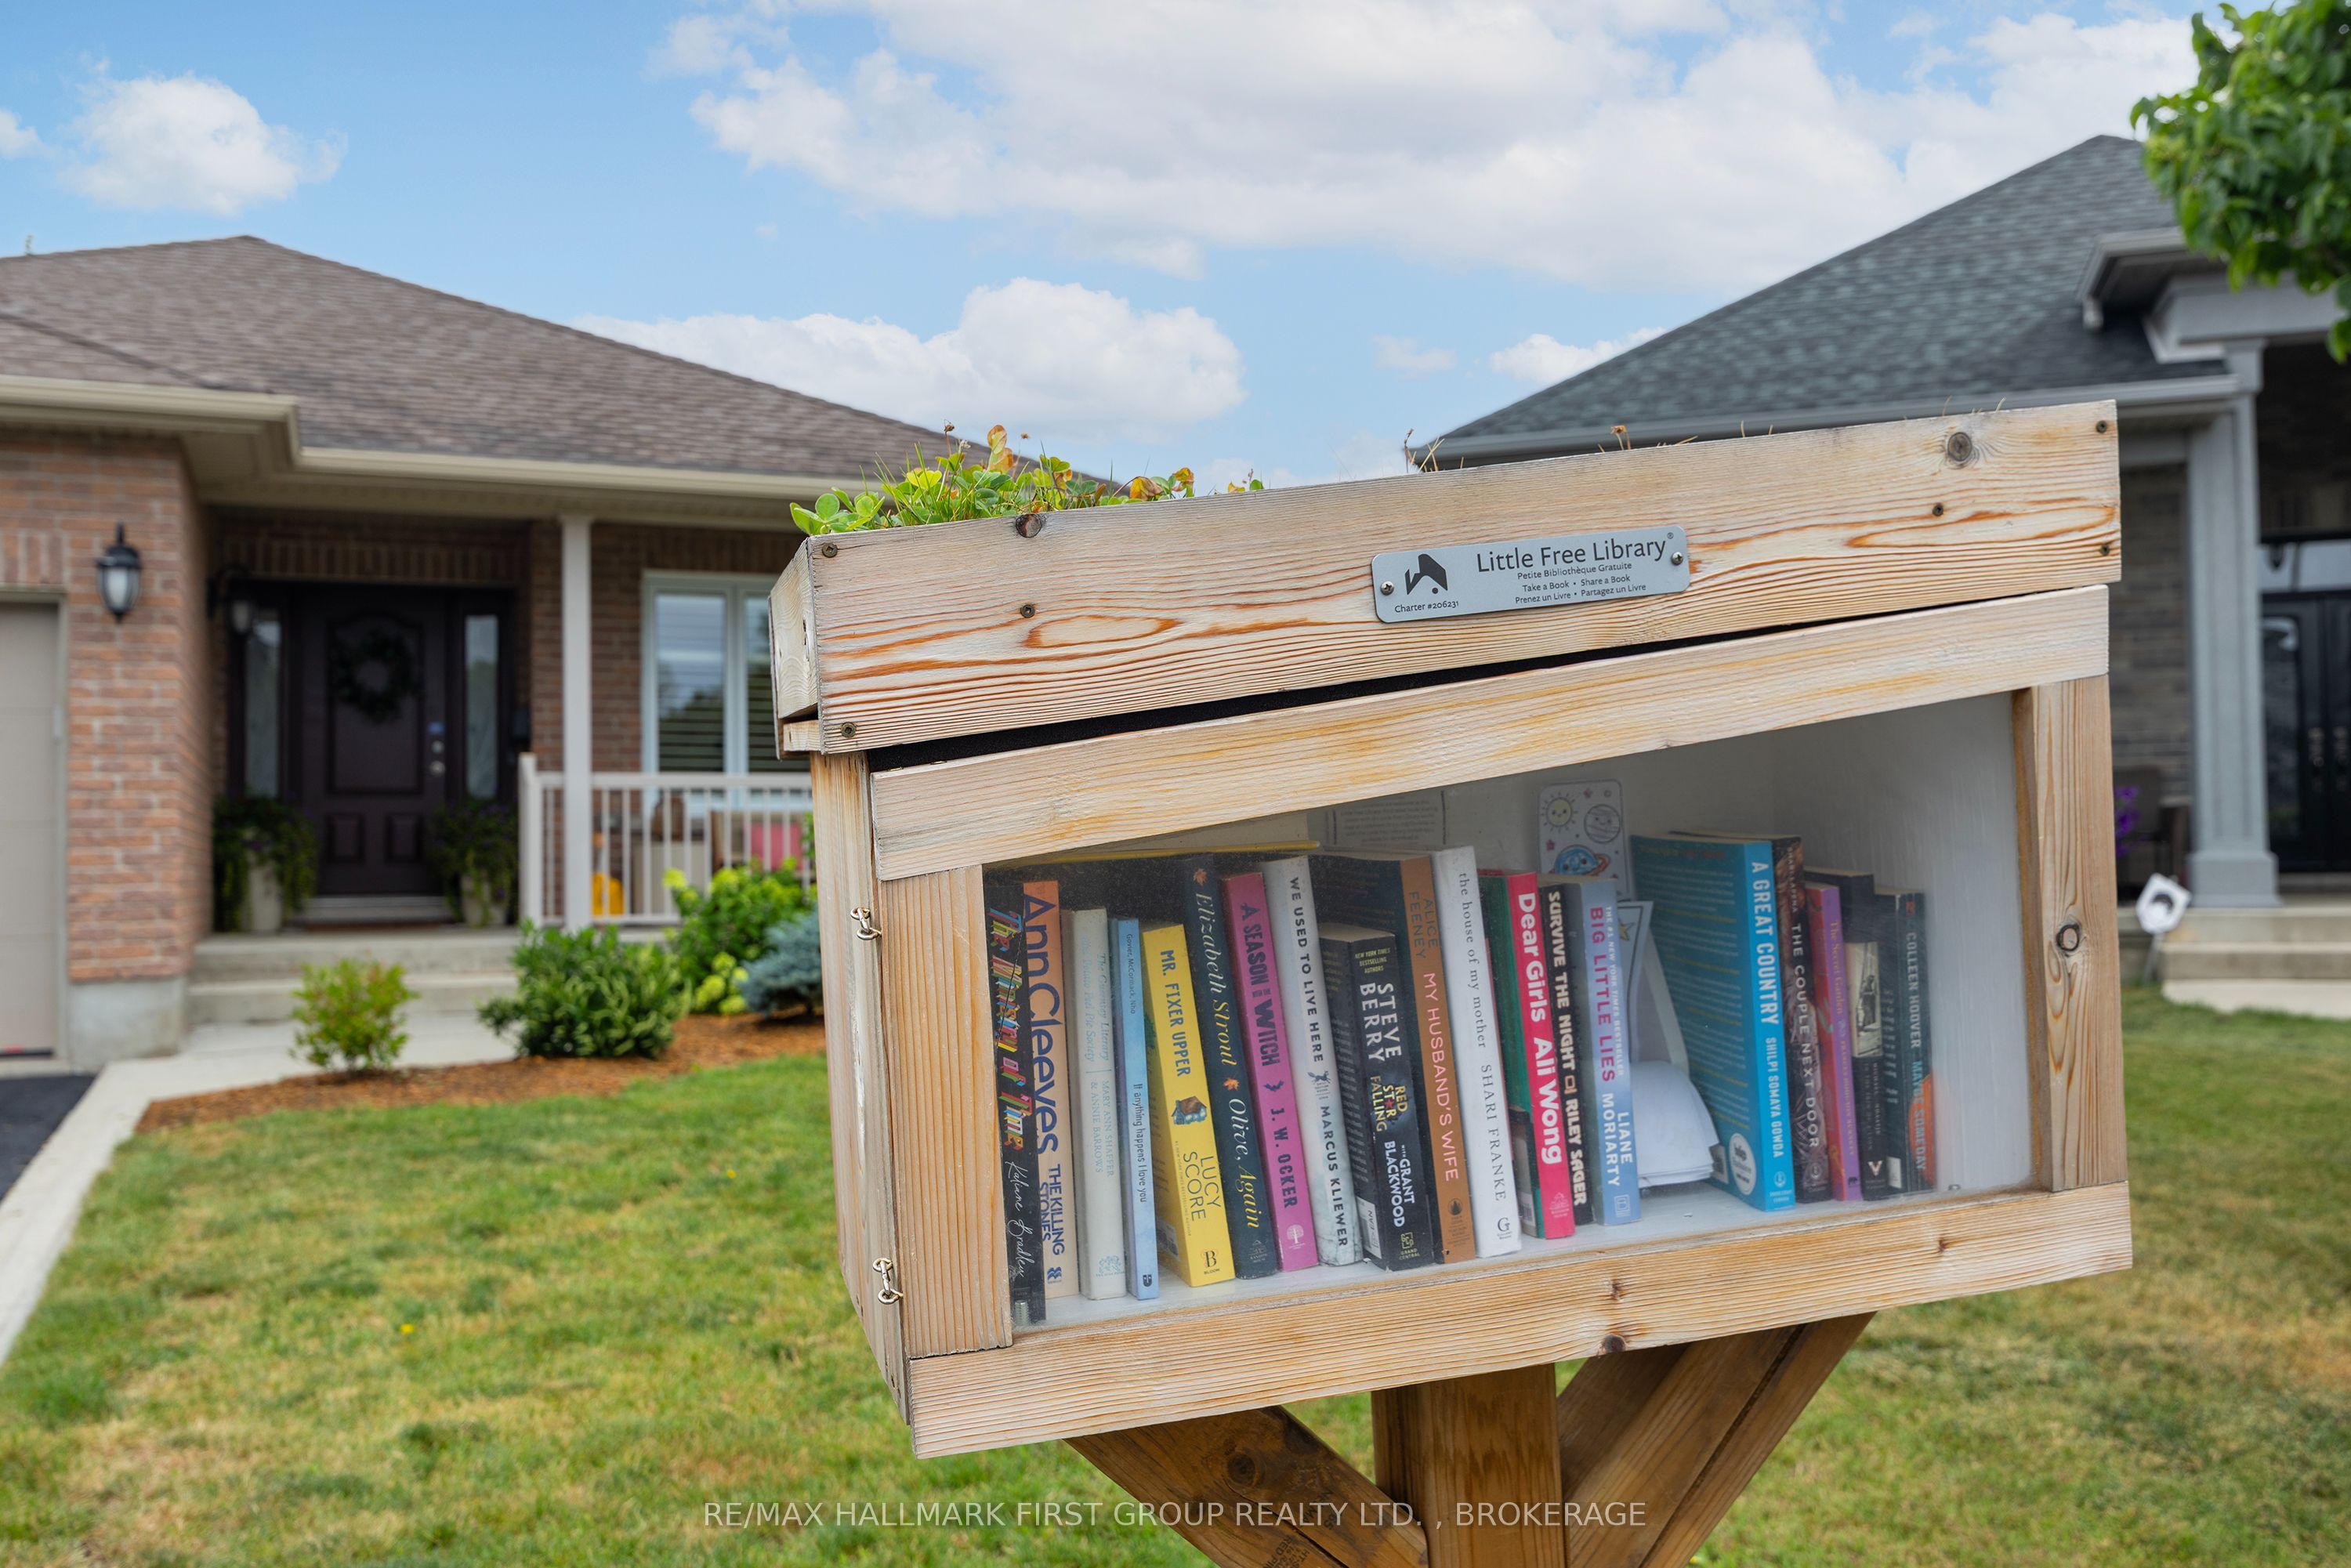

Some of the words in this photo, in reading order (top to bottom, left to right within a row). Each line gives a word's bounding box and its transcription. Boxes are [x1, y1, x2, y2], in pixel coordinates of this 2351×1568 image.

[1476, 547, 1534, 573] Little
[1540, 545, 1586, 567] Free
[1517, 570, 1541, 580] Petite
[1544, 566, 1596, 578] Bibliothèque
[1598, 562, 1632, 572] Gratuite
[1581, 578, 1604, 587] Share
[1612, 574, 1631, 583] Book
[1394, 603, 1425, 614] Charter
[1427, 600, 1459, 610] #206231
[1516, 595, 1541, 604] Prenez
[1554, 591, 1571, 600] Livre
[1522, 583, 1541, 592] Take
[1549, 580, 1570, 589] Book
[1581, 588, 1614, 598] Partagez
[1628, 583, 1646, 592] Livre
[1290, 877, 1301, 901] WE
[1459, 872, 1468, 896] the
[1752, 861, 1769, 873] A
[1241, 903, 1260, 921] A
[1294, 907, 1307, 947] USED
[1409, 891, 1425, 959] FEENEY
[1423, 899, 1437, 947] ALICE
[1462, 901, 1473, 943] house
[1519, 893, 1539, 957] Dear
[1549, 890, 1566, 969] SURVIVE
[1590, 907, 1605, 944] BIG
[1752, 880, 1773, 936] GREAT
[1830, 919, 1838, 938] The
[1023, 893, 1057, 976] Ann
[1244, 924, 1269, 985] SEASON
[1791, 924, 1802, 958] THE
[1831, 942, 1840, 971] Secret
[1097, 953, 1106, 972] The
[1127, 958, 1136, 998] McCormack,
[1160, 950, 1176, 976] MR.
[1196, 893, 1226, 993] Elizabeth
[1213, 999, 1237, 1066] Strout
[1300, 954, 1311, 974] TO
[1360, 956, 1387, 966] BESTSELLING
[1468, 950, 1480, 965] of
[1468, 969, 1480, 990] my
[1906, 931, 1918, 988] COLLEEN
[991, 954, 1023, 1052] Ministry
[1099, 975, 1110, 1019] Guernsey
[1165, 983, 1184, 1027] FIXER
[1303, 980, 1317, 1016] LIVE
[1424, 973, 1439, 1001] MY
[1526, 961, 1548, 1023] Girls
[1555, 972, 1570, 1009] THE
[1594, 954, 1611, 1026] LITTLE
[1607, 926, 1614, 938] #1
[1614, 1020, 1625, 1076] BESTSELLER
[1757, 943, 1779, 1026] COUNTRY
[1794, 965, 1809, 1034] COUPLE
[1833, 975, 1843, 1012] Garden
[1085, 1012, 1095, 1027] Pie
[1100, 1022, 1110, 1060] Literary
[1255, 998, 1280, 1066] WITCH
[1360, 982, 1386, 1062] BERRY
[1378, 983, 1402, 1058] STEVE
[1473, 996, 1486, 1048] mother
[1909, 994, 1922, 1047] HOOVER
[1085, 1029, 1096, 1062] Society
[1172, 1032, 1191, 1077] UPPER
[1310, 1022, 1324, 1062] HERE
[1534, 1037, 1556, 1076] Ali
[1559, 1014, 1576, 1071] NIGHT
[1599, 1035, 1616, 1082] LIES
[1766, 1037, 1779, 1073] SHILPI
[1028, 983, 1063, 1155] Cleeves
[1427, 1009, 1452, 1126] HUSBAND'S
[1802, 1043, 1814, 1088] NEXT
[1911, 1060, 1922, 1102] MAYBE
[1090, 1092, 1100, 1123] ANNIE
[1133, 1092, 1143, 1127] anything
[1271, 1107, 1284, 1121] J.
[1371, 1076, 1387, 1132] FALLING
[1395, 1086, 1408, 1113] RED
[1481, 1065, 1497, 1120] SHARI
[1769, 1075, 1783, 1117] SOMAYA
[1103, 1110, 1112, 1132] ANN
[1229, 1098, 1249, 1161] Olive,
[1273, 1126, 1288, 1147] W.
[1538, 1079, 1562, 1164] Wong
[1566, 1099, 1581, 1145] RILEY
[1602, 1092, 1621, 1186] MORIARTY
[1617, 1112, 1633, 1164] LIANE
[1771, 1122, 1784, 1158] GOWDA
[1806, 1097, 1820, 1147] DOOR
[1913, 1109, 1925, 1170] SOMEDAY
[1092, 1126, 1103, 1173] BARROWS
[1104, 1135, 1114, 1177] SHAFFER
[1136, 1128, 1147, 1163] happens
[1442, 1131, 1458, 1181] WIFE
[1488, 1128, 1506, 1201] FRANKE
[1049, 1164, 1062, 1194] THE
[1139, 1189, 1147, 1203] you
[1183, 1151, 1206, 1221] SCORE
[1201, 1156, 1221, 1208] LUCY
[1235, 1165, 1262, 1229] Again
[1278, 1153, 1298, 1208] OCKER
[1320, 1106, 1339, 1171] MARCUS
[1331, 1179, 1348, 1246] KLIEWER
[1384, 1140, 1405, 1228] BLACKWOOD
[1400, 1158, 1415, 1204] GRANT
[1570, 1150, 1587, 1207] SAGER
[1039, 1182, 1051, 1242] STONES
[1050, 1197, 1065, 1255] KILLING
[1204, 1251, 1217, 1268] B
